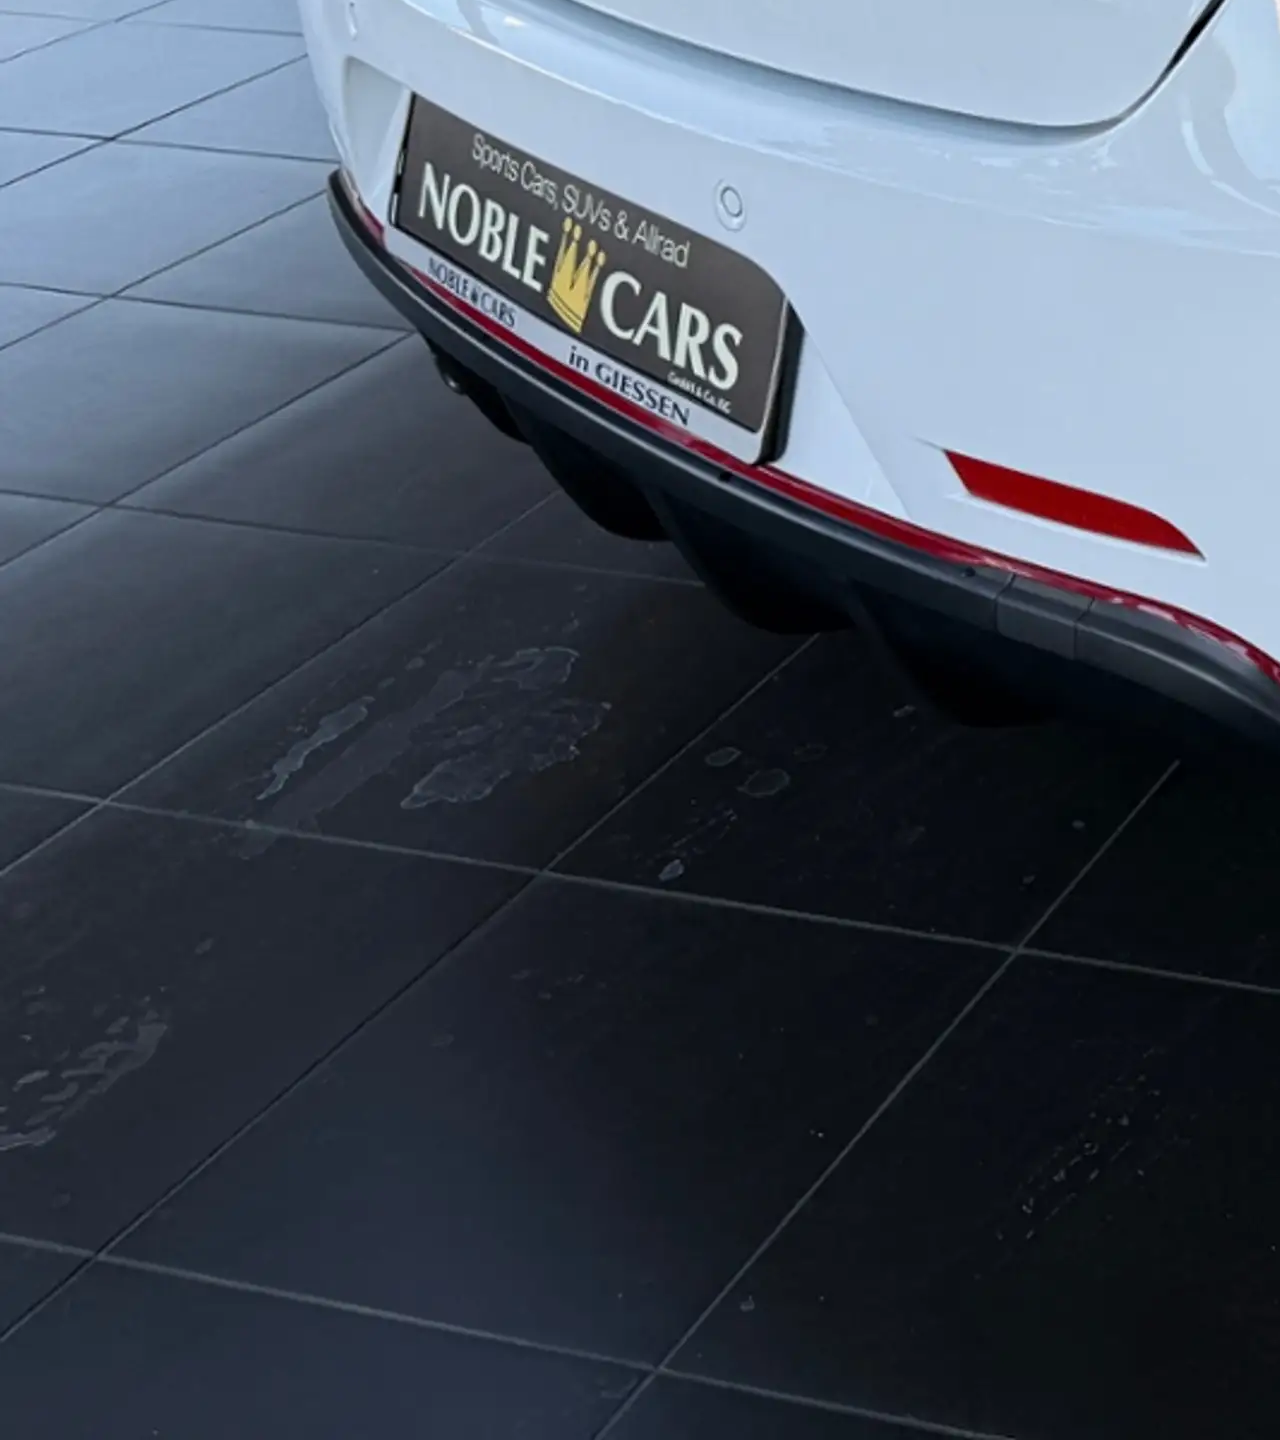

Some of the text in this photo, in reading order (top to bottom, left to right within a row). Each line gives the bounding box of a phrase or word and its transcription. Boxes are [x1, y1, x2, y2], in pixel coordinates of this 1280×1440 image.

[472, 133, 691, 269] Sports Cars, SUVs & Allrad
[418, 162, 743, 391] NOBLE CARS
[427, 257, 469, 299] NOBLE
[567, 345, 691, 427] in GIESSEN
